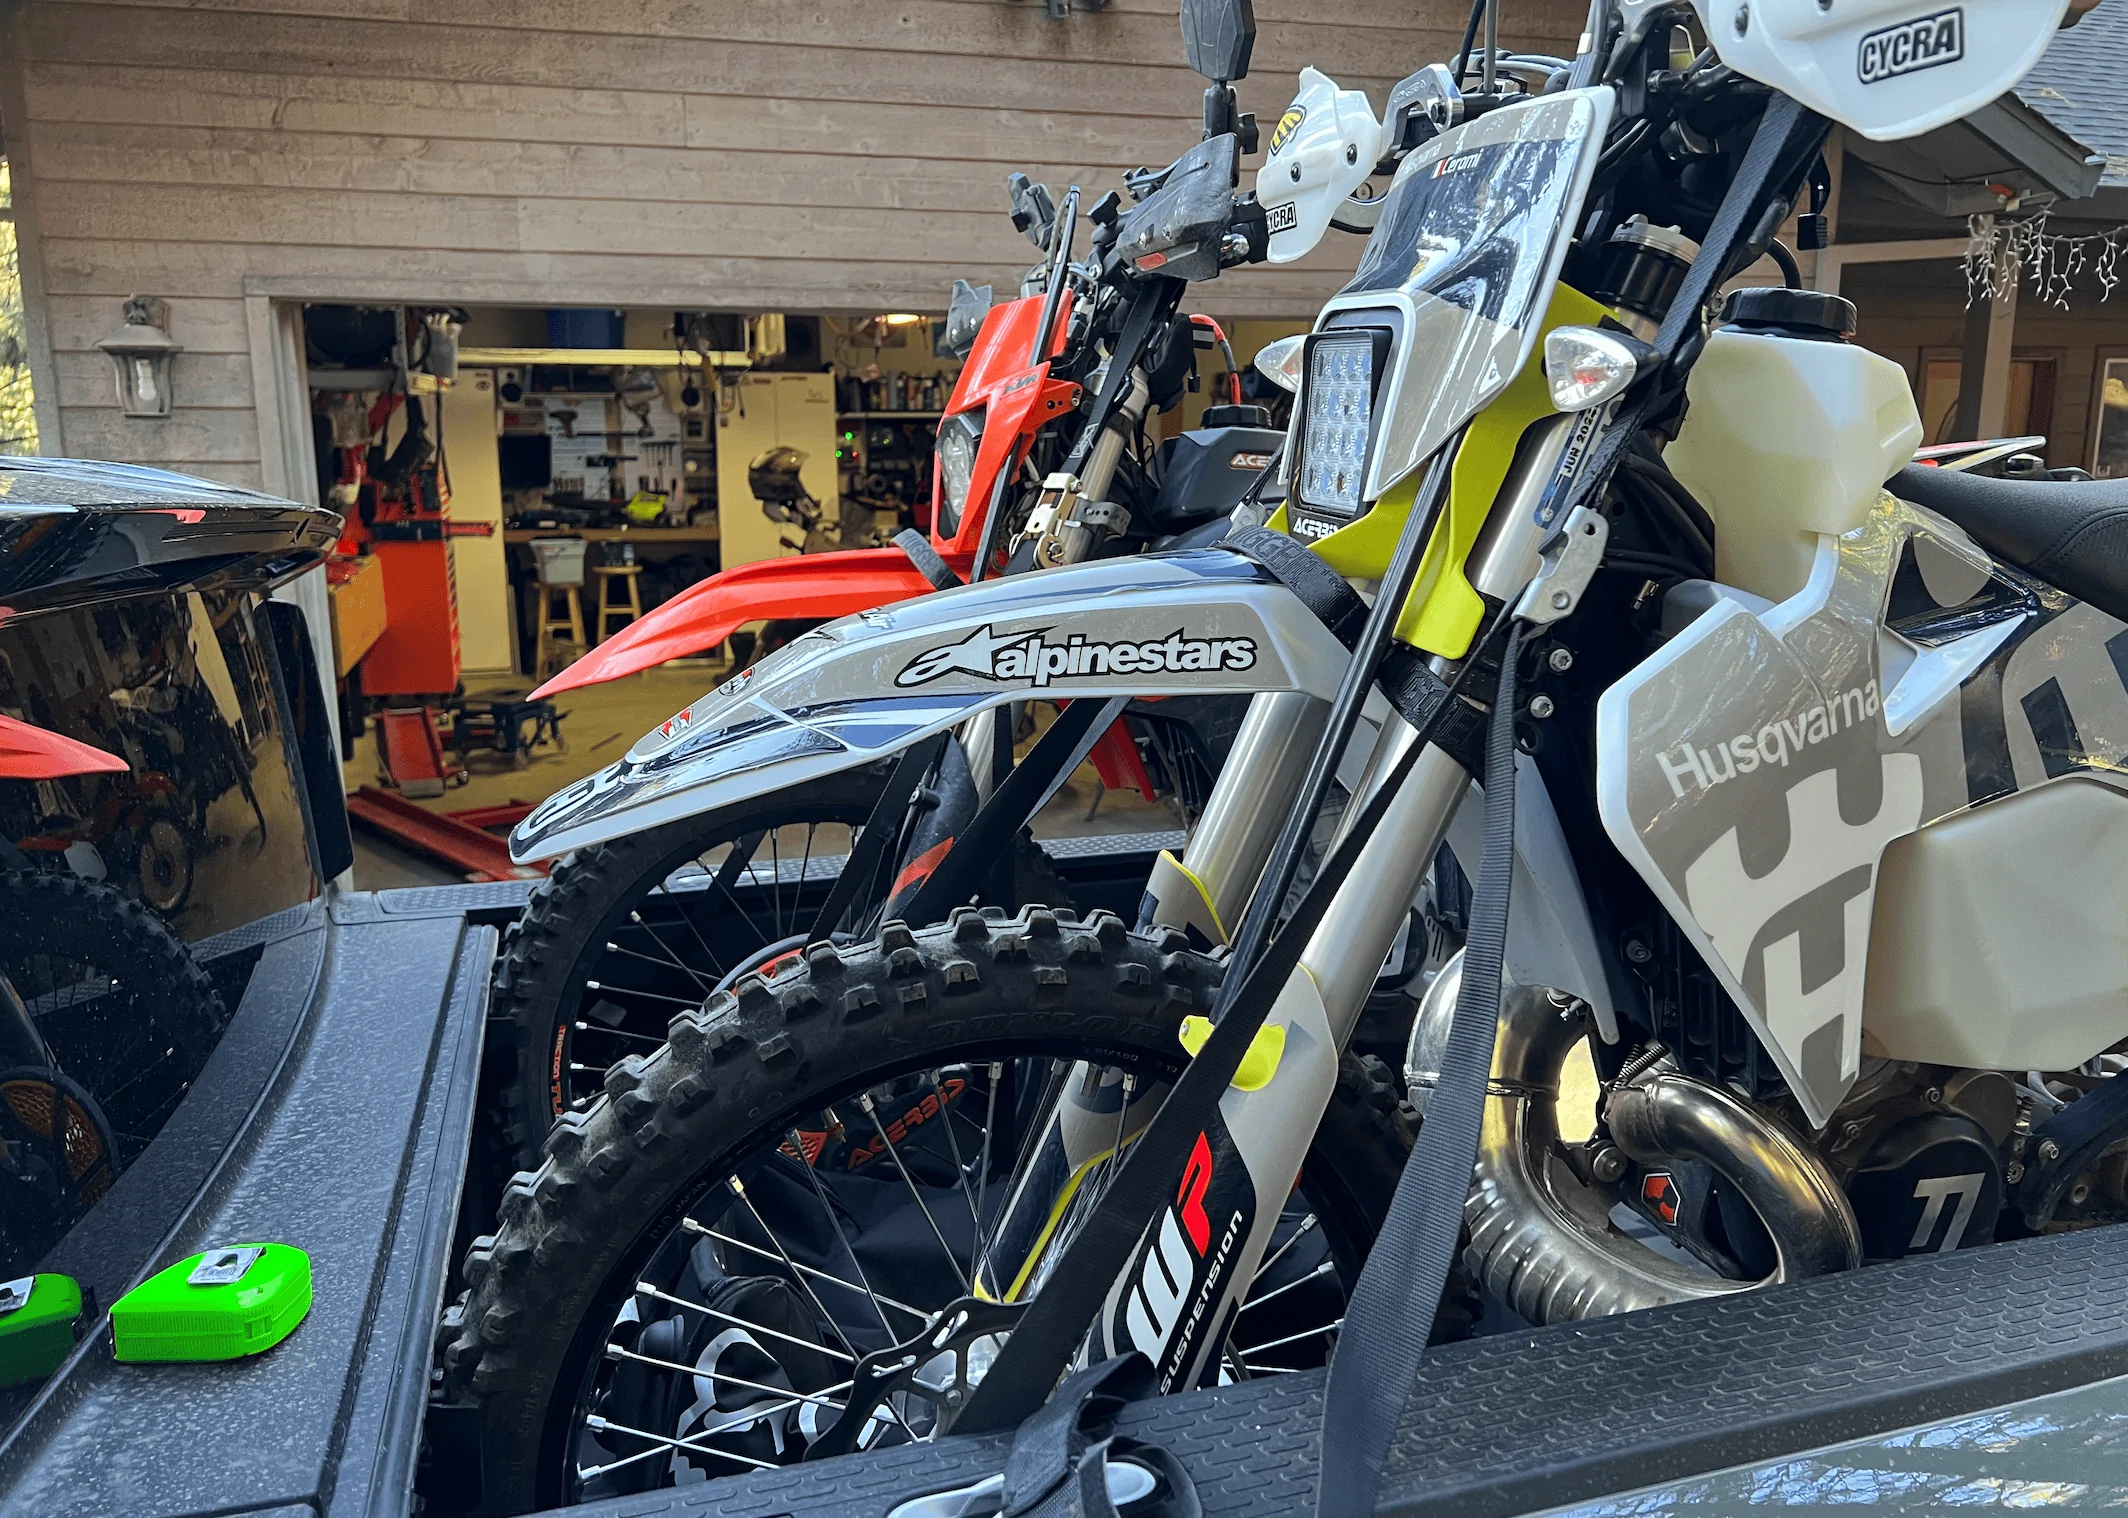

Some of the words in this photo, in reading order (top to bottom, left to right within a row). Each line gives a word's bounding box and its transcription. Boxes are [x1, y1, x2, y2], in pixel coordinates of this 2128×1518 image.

[1863, 17, 1957, 76] CYCRA
[1266, 205, 1295, 231] YCRA
[994, 627, 1257, 687] alpinestars
[1654, 678, 1882, 799] Husqvarna
[1159, 1207, 1243, 1397] SUSPENSION
